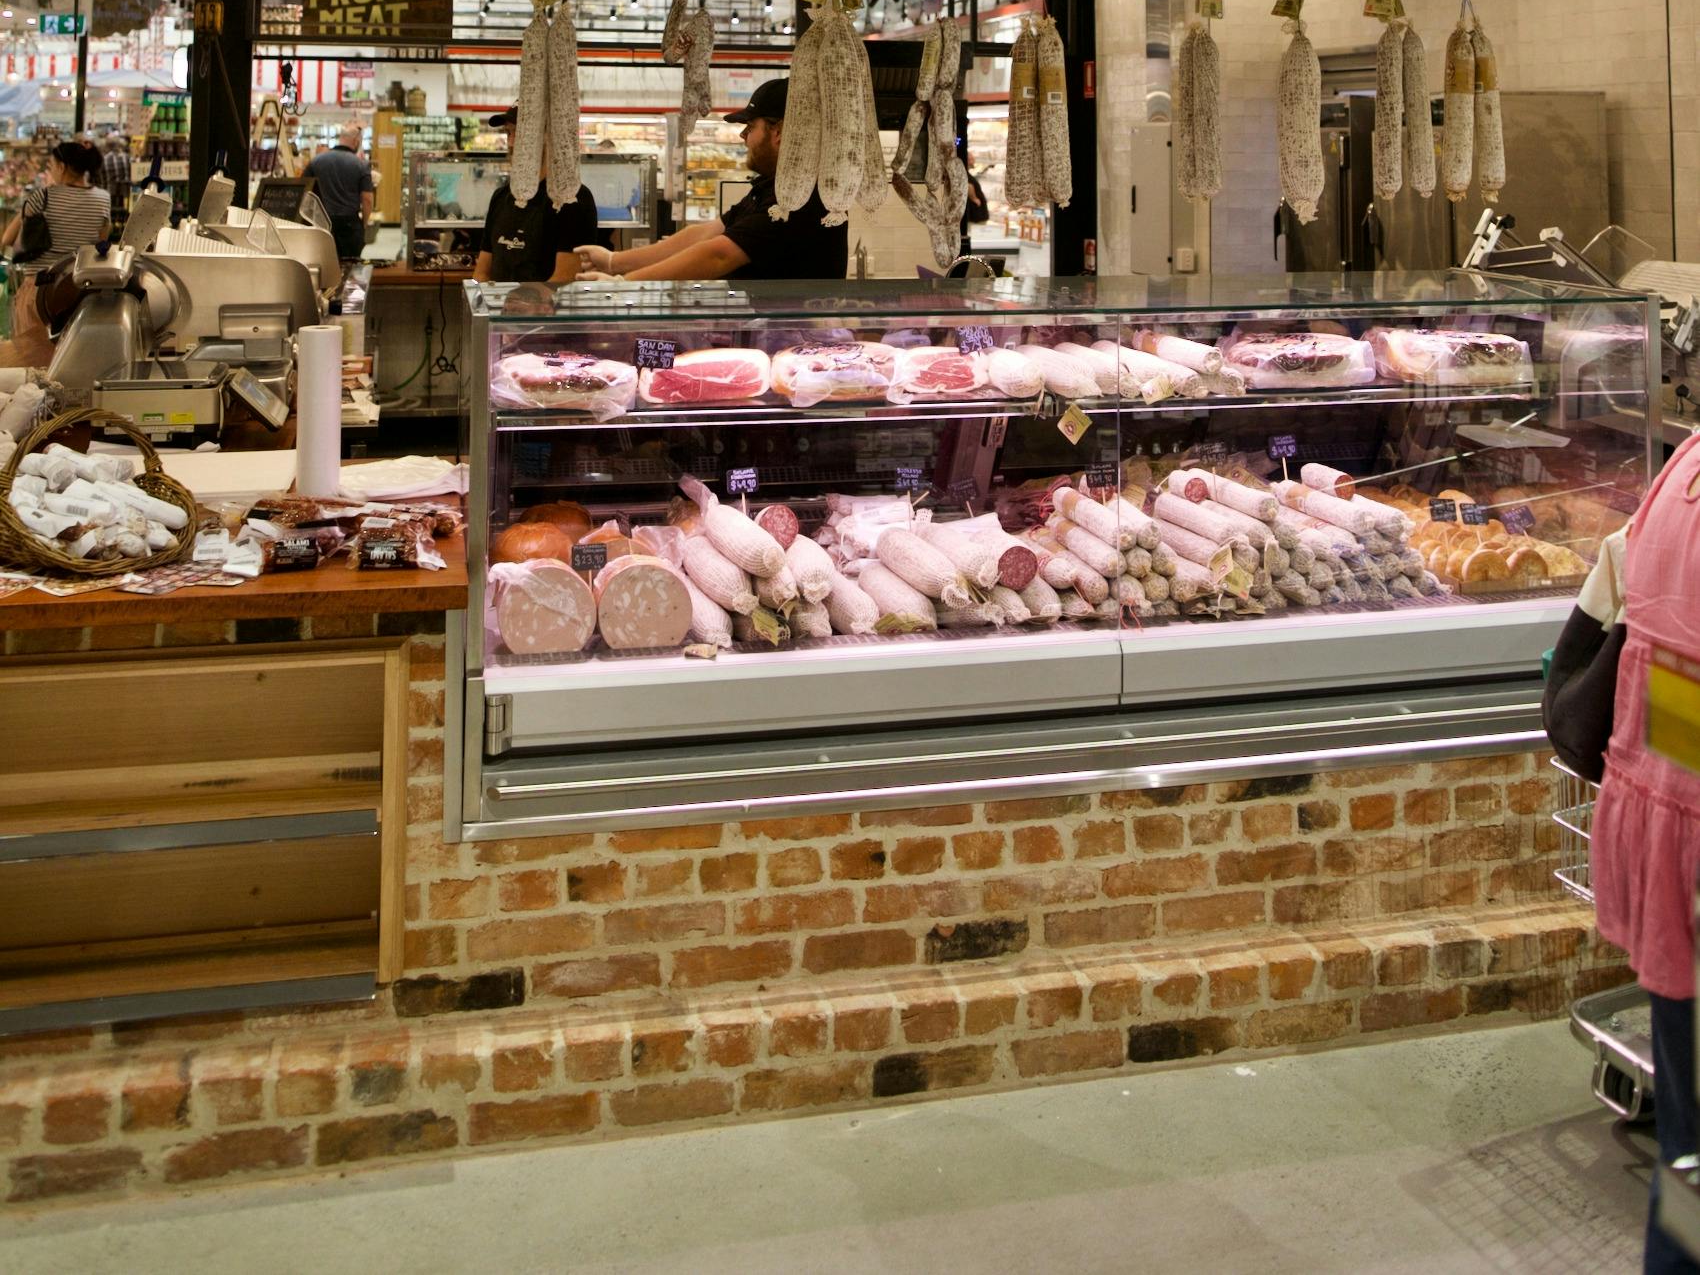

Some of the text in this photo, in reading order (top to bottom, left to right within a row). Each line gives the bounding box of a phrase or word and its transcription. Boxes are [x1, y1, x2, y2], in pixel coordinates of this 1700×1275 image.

[318, 2, 409, 36] MEAT
[637, 340, 656, 349] SAN
[284, 538, 310, 546] SALAMI
[370, 548, 397, 560] SALAMI
